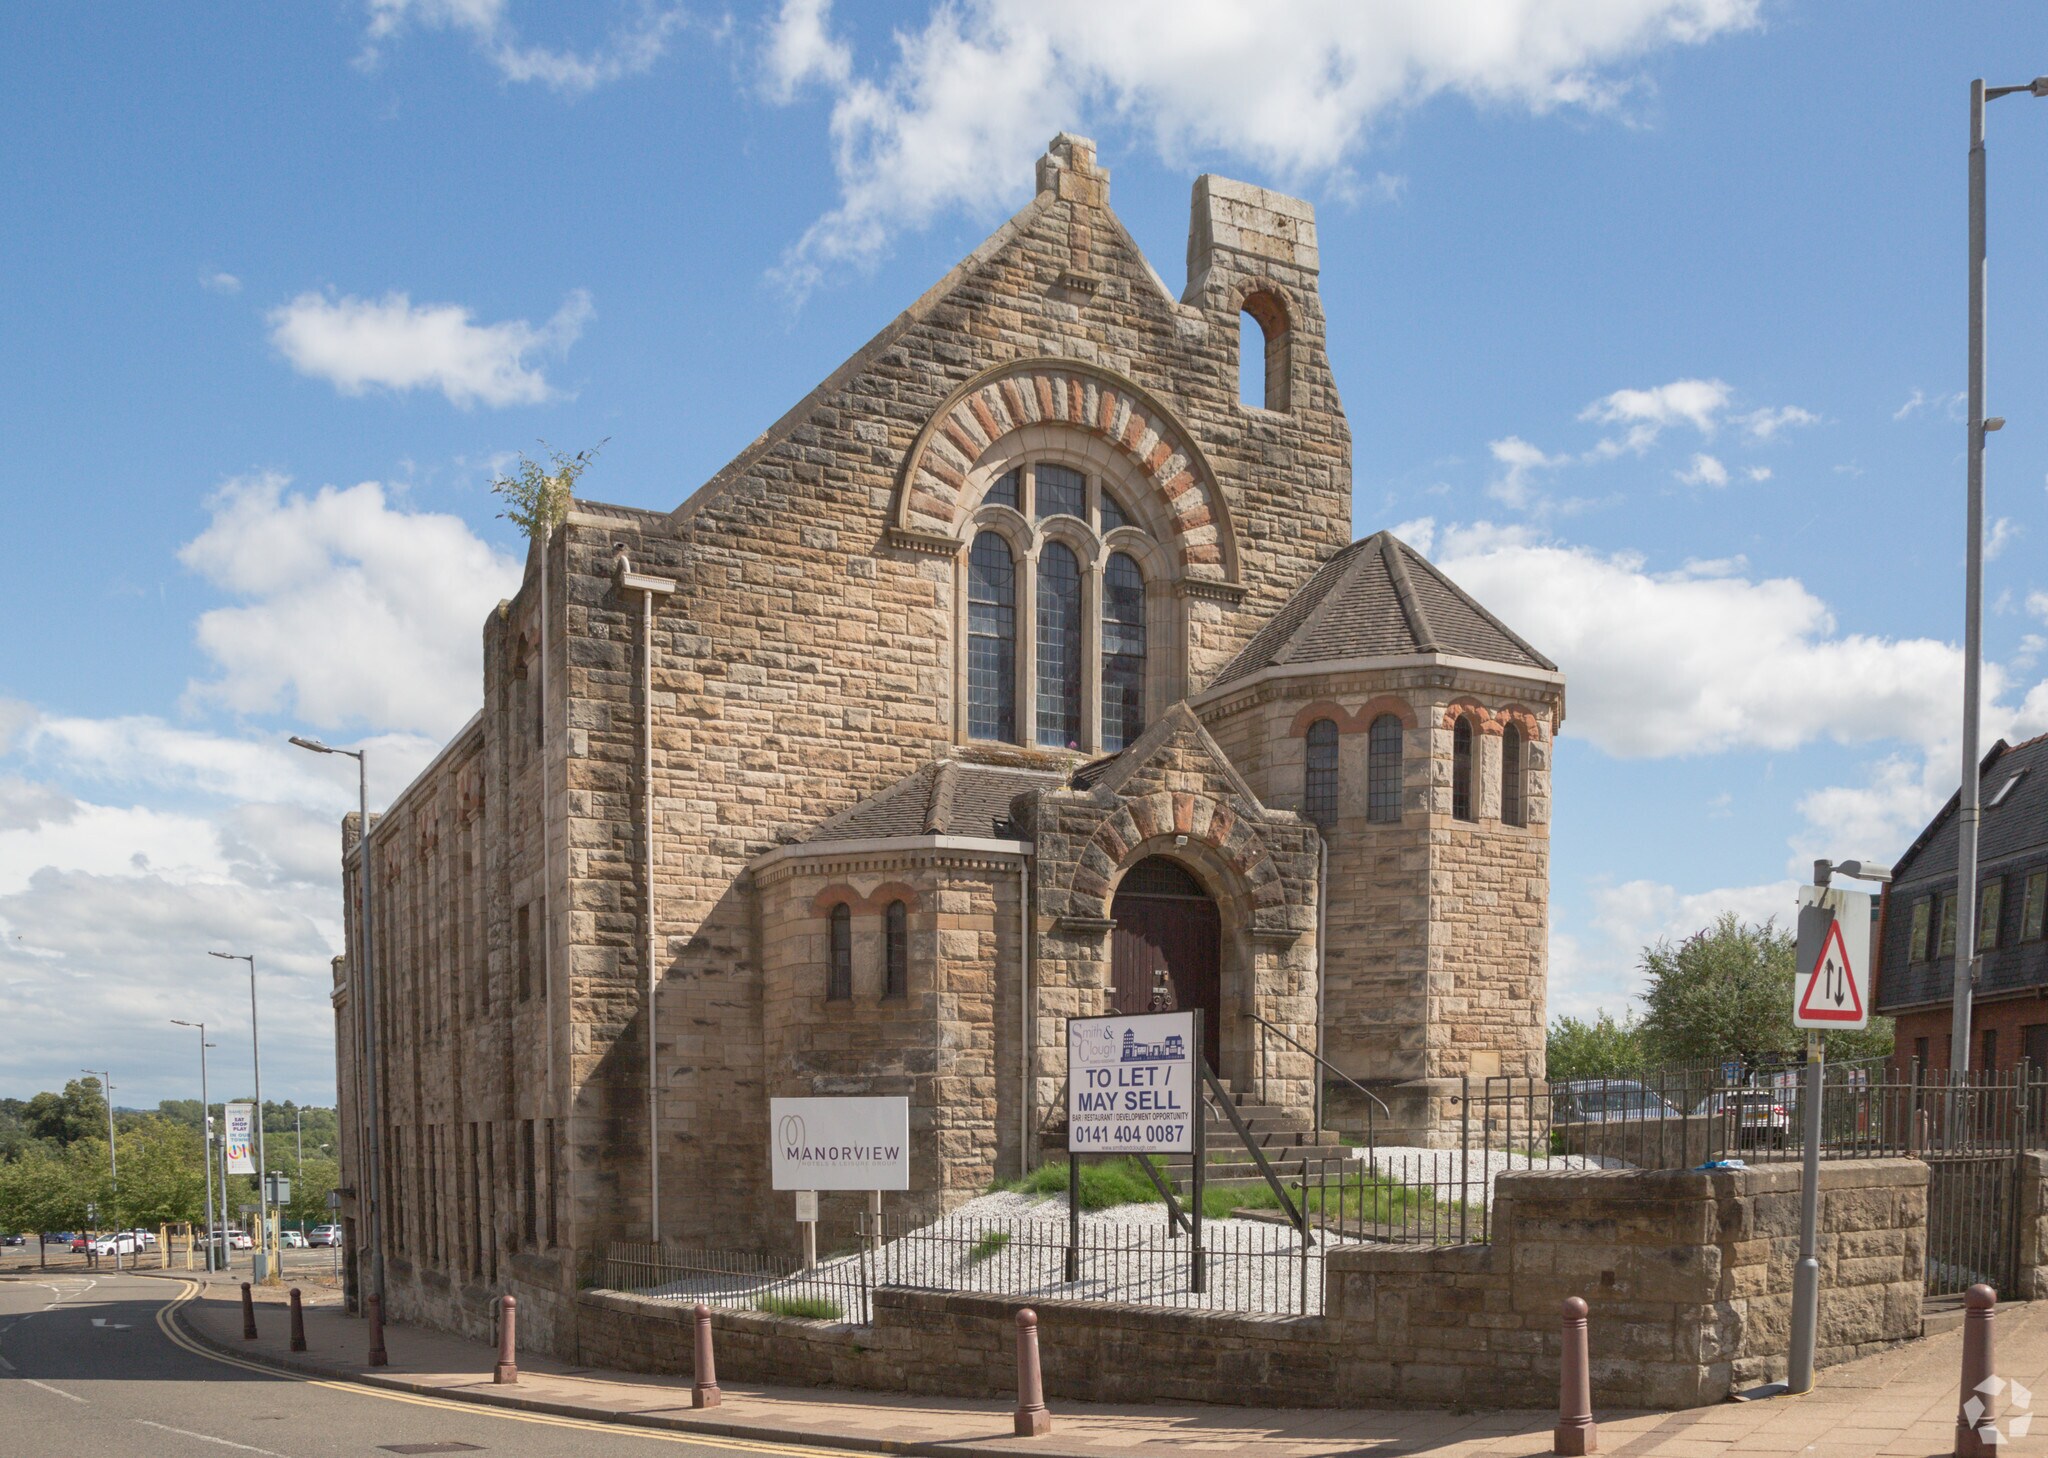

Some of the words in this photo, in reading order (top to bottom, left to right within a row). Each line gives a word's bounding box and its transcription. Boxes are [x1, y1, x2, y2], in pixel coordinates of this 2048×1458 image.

[1072, 1023, 1103, 1047] Smith
[1104, 1025, 1114, 1040] &
[1079, 1039, 1116, 1062] Clough
[1086, 1068, 1111, 1088] TO
[1118, 1067, 1158, 1087] LET
[1165, 1066, 1172, 1085] /
[1078, 1092, 1118, 1111] MAY
[1124, 1090, 1181, 1111] SELL
[1072, 1114, 1082, 1122] BAR
[1084, 1113, 1113, 1121] RESTAURANT
[1116, 1112, 1152, 1121] DEVELOPMENT
[1153, 1112, 1189, 1120] OPPORTUNITY
[1076, 1126, 1108, 1142] 0141
[1114, 1125, 1142, 1142] 404
[1146, 1125, 1184, 1142] 0087
[787, 1147, 899, 1160] MANORVIEW
